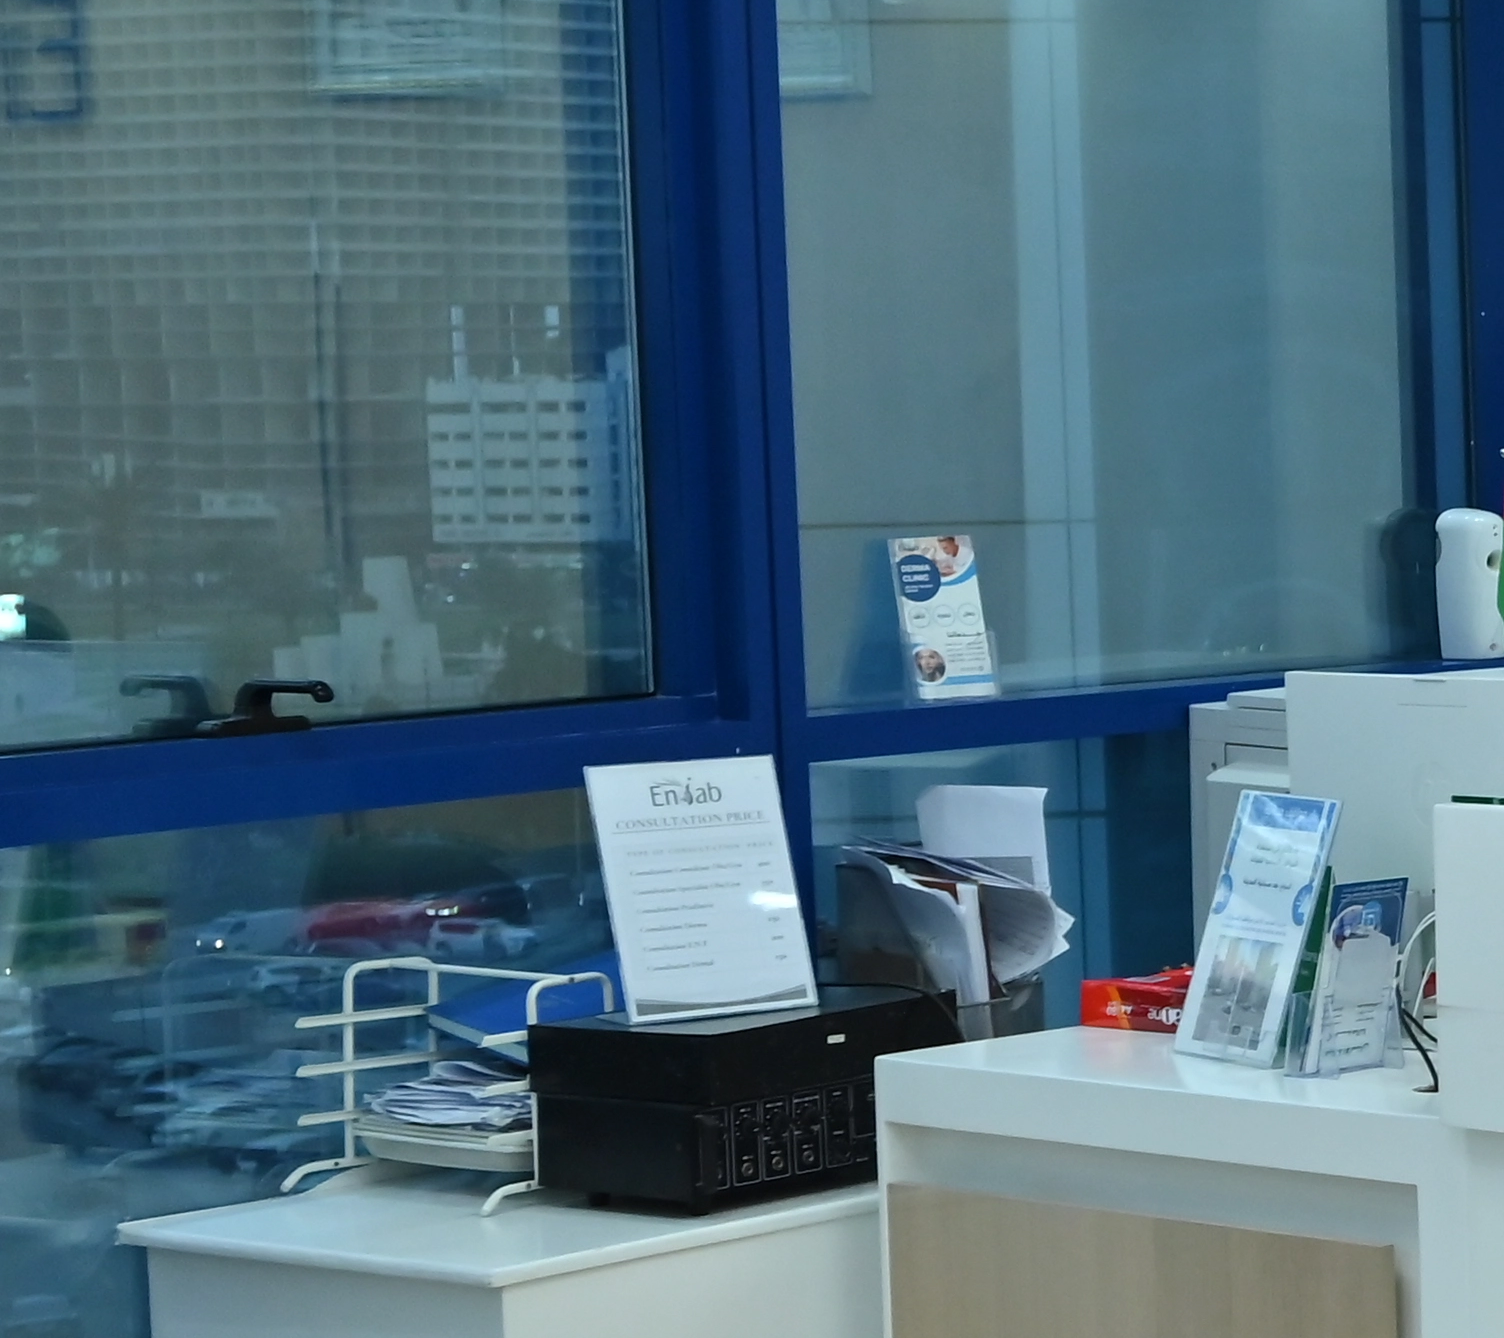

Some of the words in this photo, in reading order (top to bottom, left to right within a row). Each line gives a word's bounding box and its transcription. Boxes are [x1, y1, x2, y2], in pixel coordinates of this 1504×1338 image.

[650, 777, 722, 808] Enjab
[615, 814, 723, 831] CONSULTATION
[726, 809, 767, 823] PRICE
